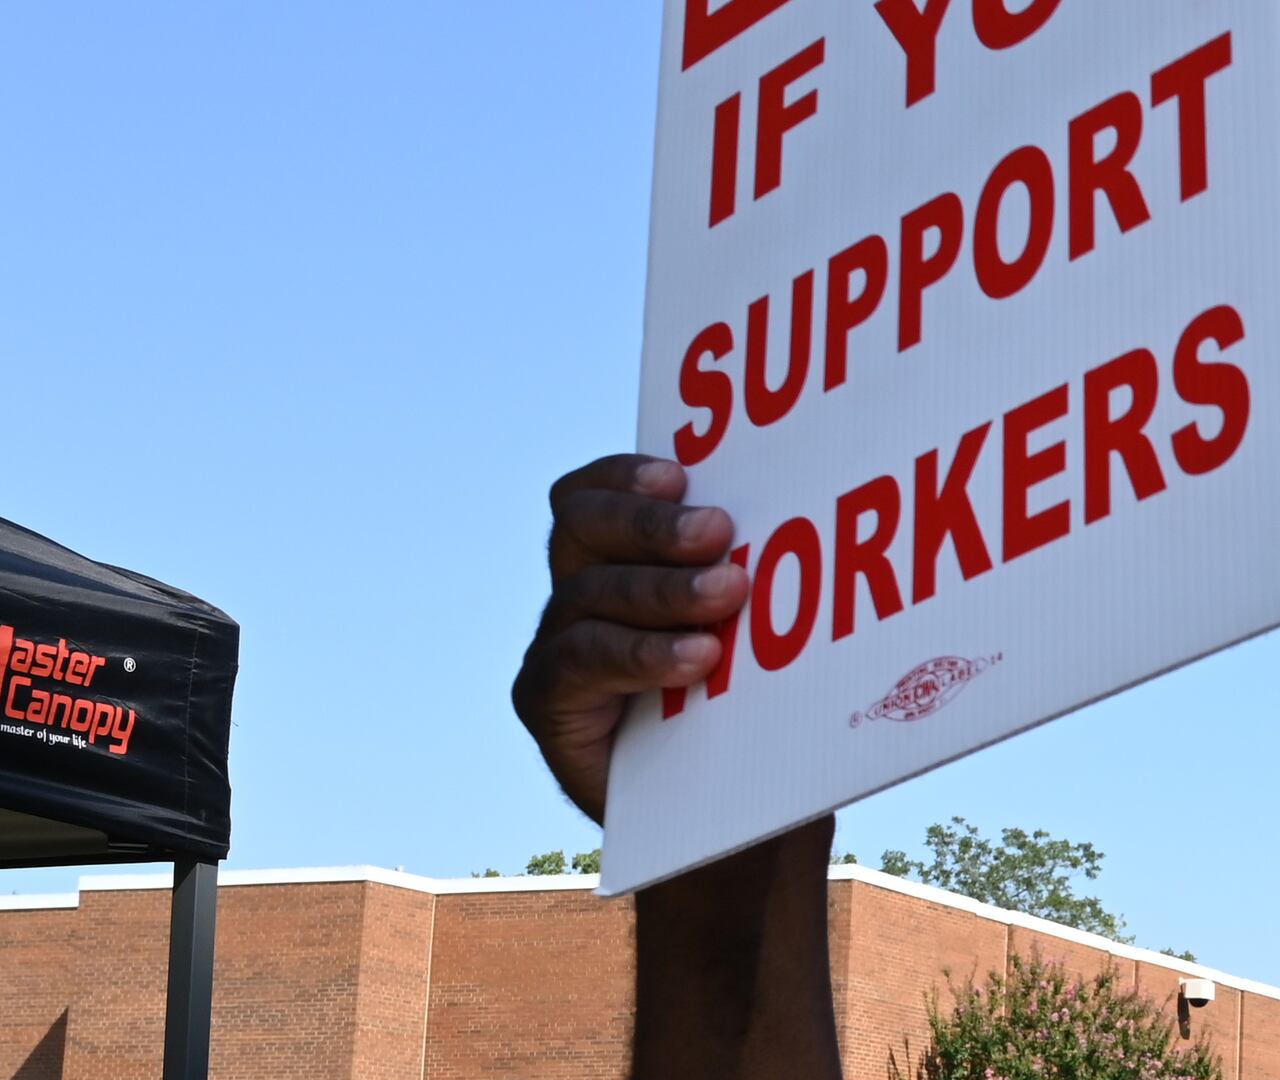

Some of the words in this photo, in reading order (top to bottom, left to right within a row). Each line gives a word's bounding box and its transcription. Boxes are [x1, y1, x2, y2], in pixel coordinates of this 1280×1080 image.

[709, 36, 826, 229] IF
[672, 30, 1233, 467] SUPPORT
[0, 723, 35, 738] master
[36, 727, 47, 743] of
[49, 732, 71, 746] your
[72, 733, 87, 750] life
[4, 674, 137, 755] Canopy
